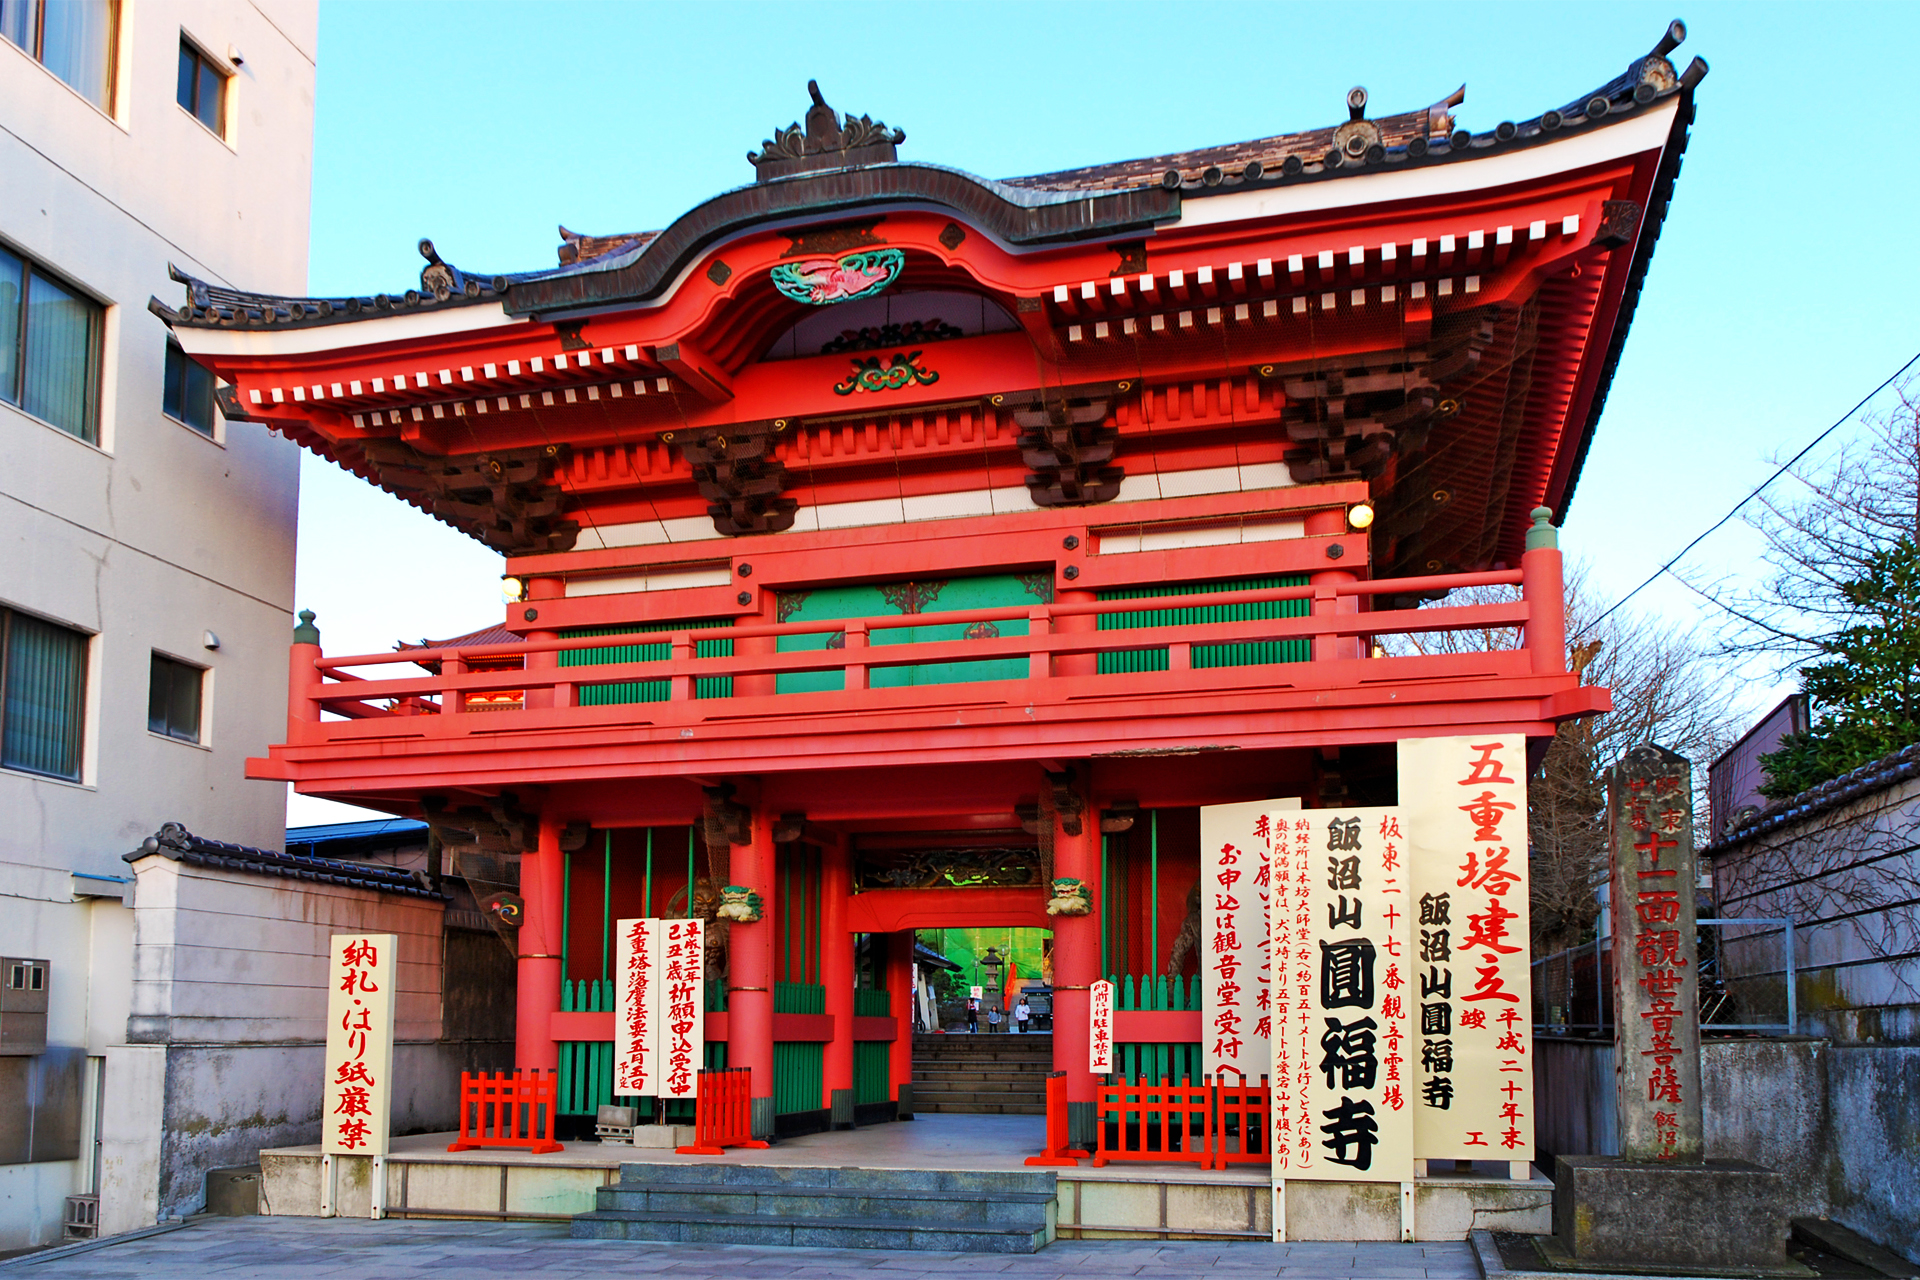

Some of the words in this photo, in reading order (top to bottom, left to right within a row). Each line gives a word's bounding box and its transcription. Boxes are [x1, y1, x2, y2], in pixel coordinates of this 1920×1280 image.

[1212, 843, 1243, 1075] お申込は観音堂受付へ
[1379, 815, 1406, 1111] 板東二十七番観音霊場
[1456, 742, 1523, 1003] 五重塔建立
[334, 939, 379, 1150] 納札・はり紙厳禁
[617, 1061, 630, 1089] 予定
[626, 921, 652, 1090] 五重塔落慶法要五月五日
[667, 982, 696, 1096] 祈願申込受付中
[1092, 983, 1109, 1067] 門前に付駐車禁止
[1319, 816, 1379, 1171] 飯沼山圓福寺
[1420, 893, 1454, 1110] 飯沼山圓福寺
[1495, 1007, 1526, 1150] 平成二十年末
[1653, 1111, 1679, 1160] 飯沼山
